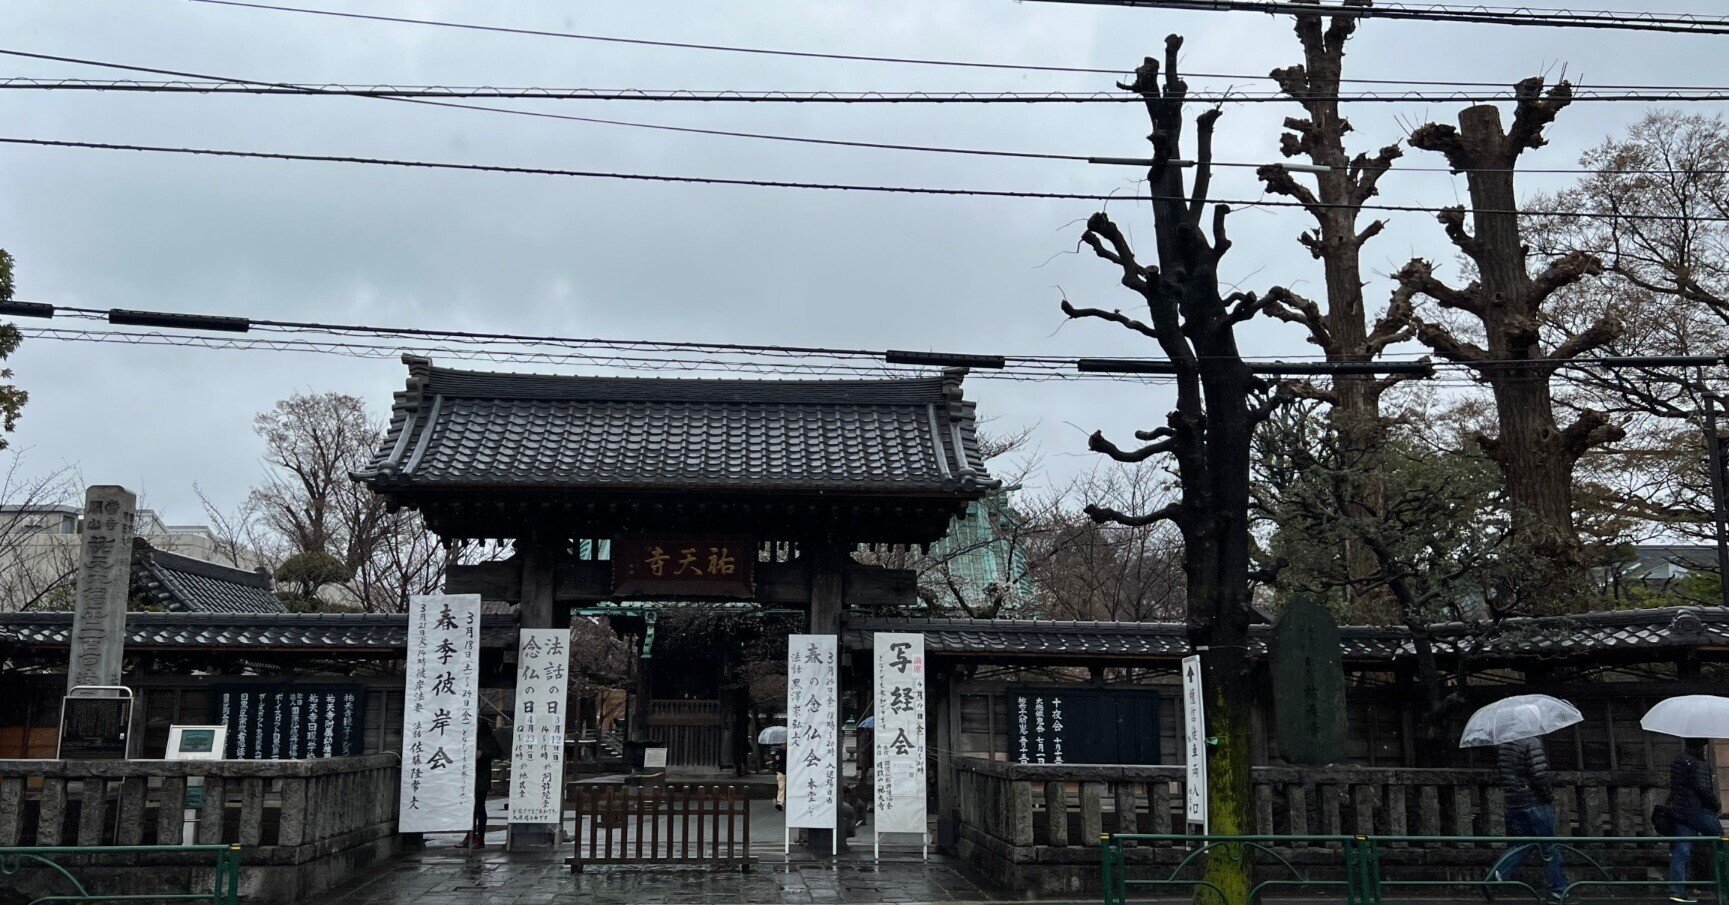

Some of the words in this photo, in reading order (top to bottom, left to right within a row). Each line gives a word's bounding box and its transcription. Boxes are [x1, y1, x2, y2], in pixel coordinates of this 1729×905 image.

[644, 546, 735, 576] 祐天寺
[426, 603, 459, 771] 春季彼岸会
[522, 635, 541, 714] 念仏の日
[543, 636, 565, 714] 法話の日
[803, 643, 823, 767] 春の念仏会
[889, 642, 915, 755] 写経会
[1052, 697, 1063, 732] 十夜会
